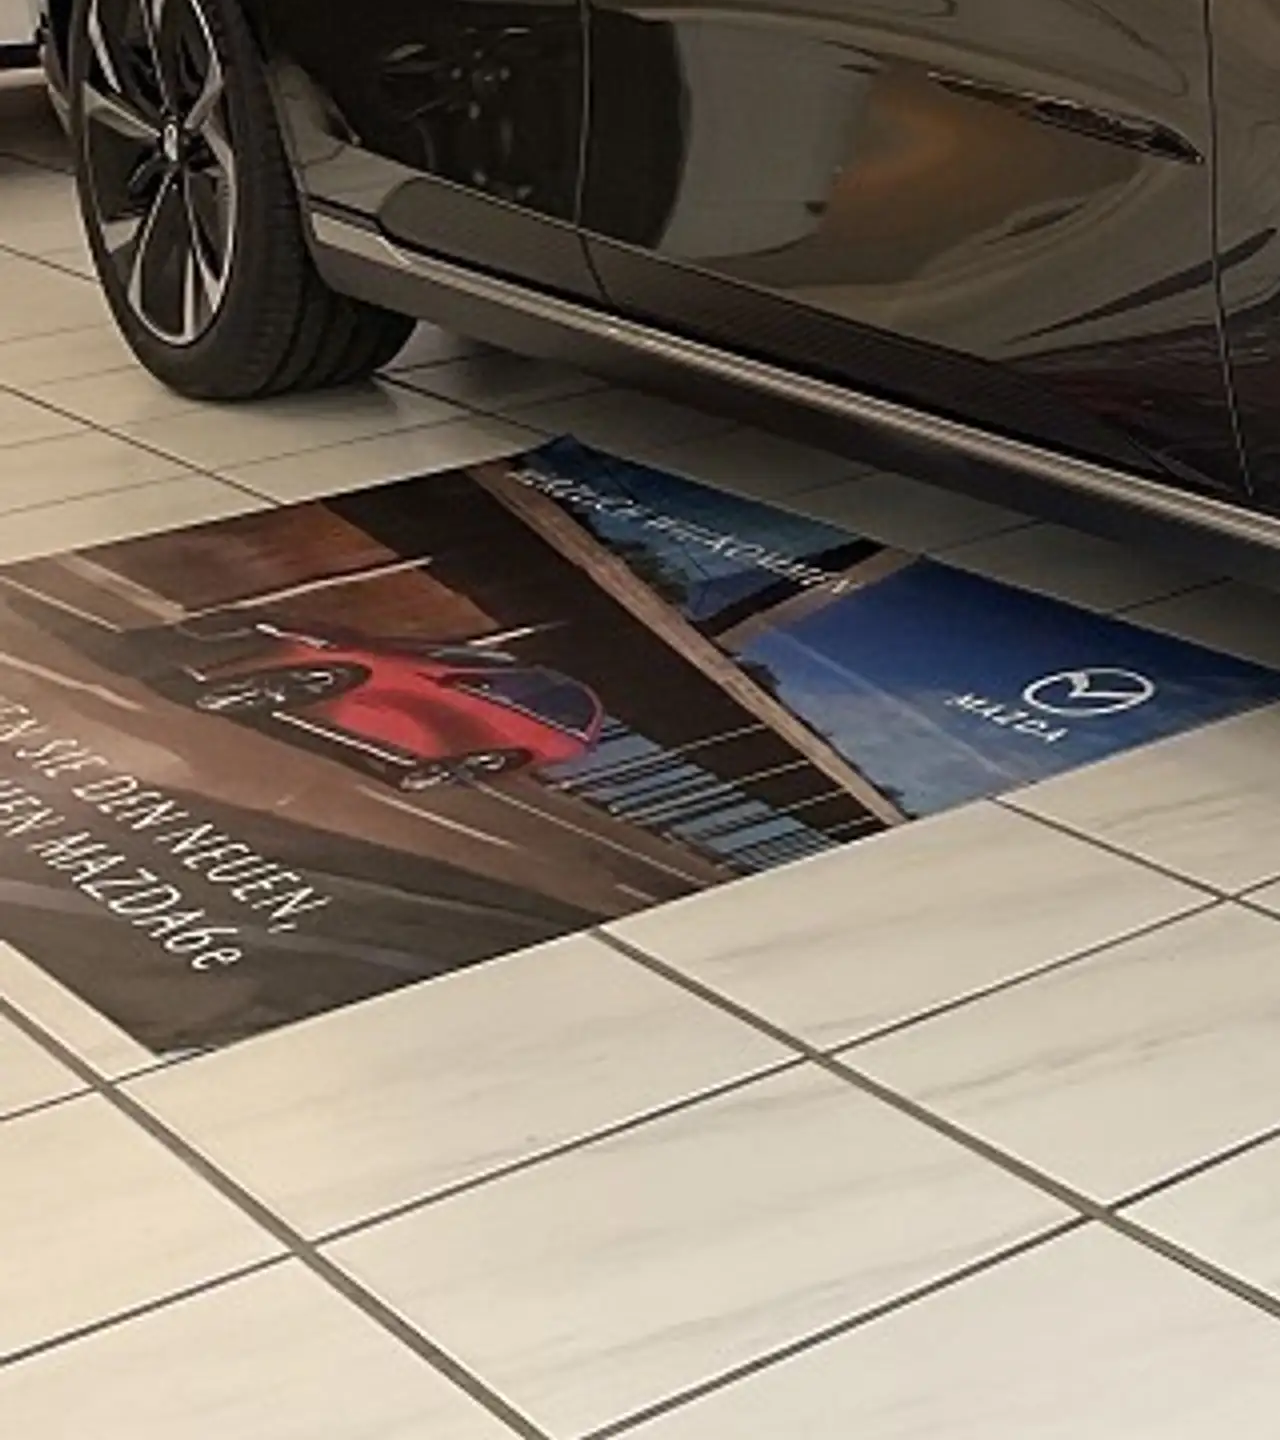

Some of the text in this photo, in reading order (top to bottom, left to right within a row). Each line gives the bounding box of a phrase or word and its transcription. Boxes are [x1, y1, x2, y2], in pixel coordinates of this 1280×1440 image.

[943, 692, 1069, 743] MAZDA
[14, 738, 110, 779] SIE
[71, 774, 190, 831] DEN
[153, 822, 333, 935] NEUEN,
[26, 830, 243, 971] MAZDA6e
